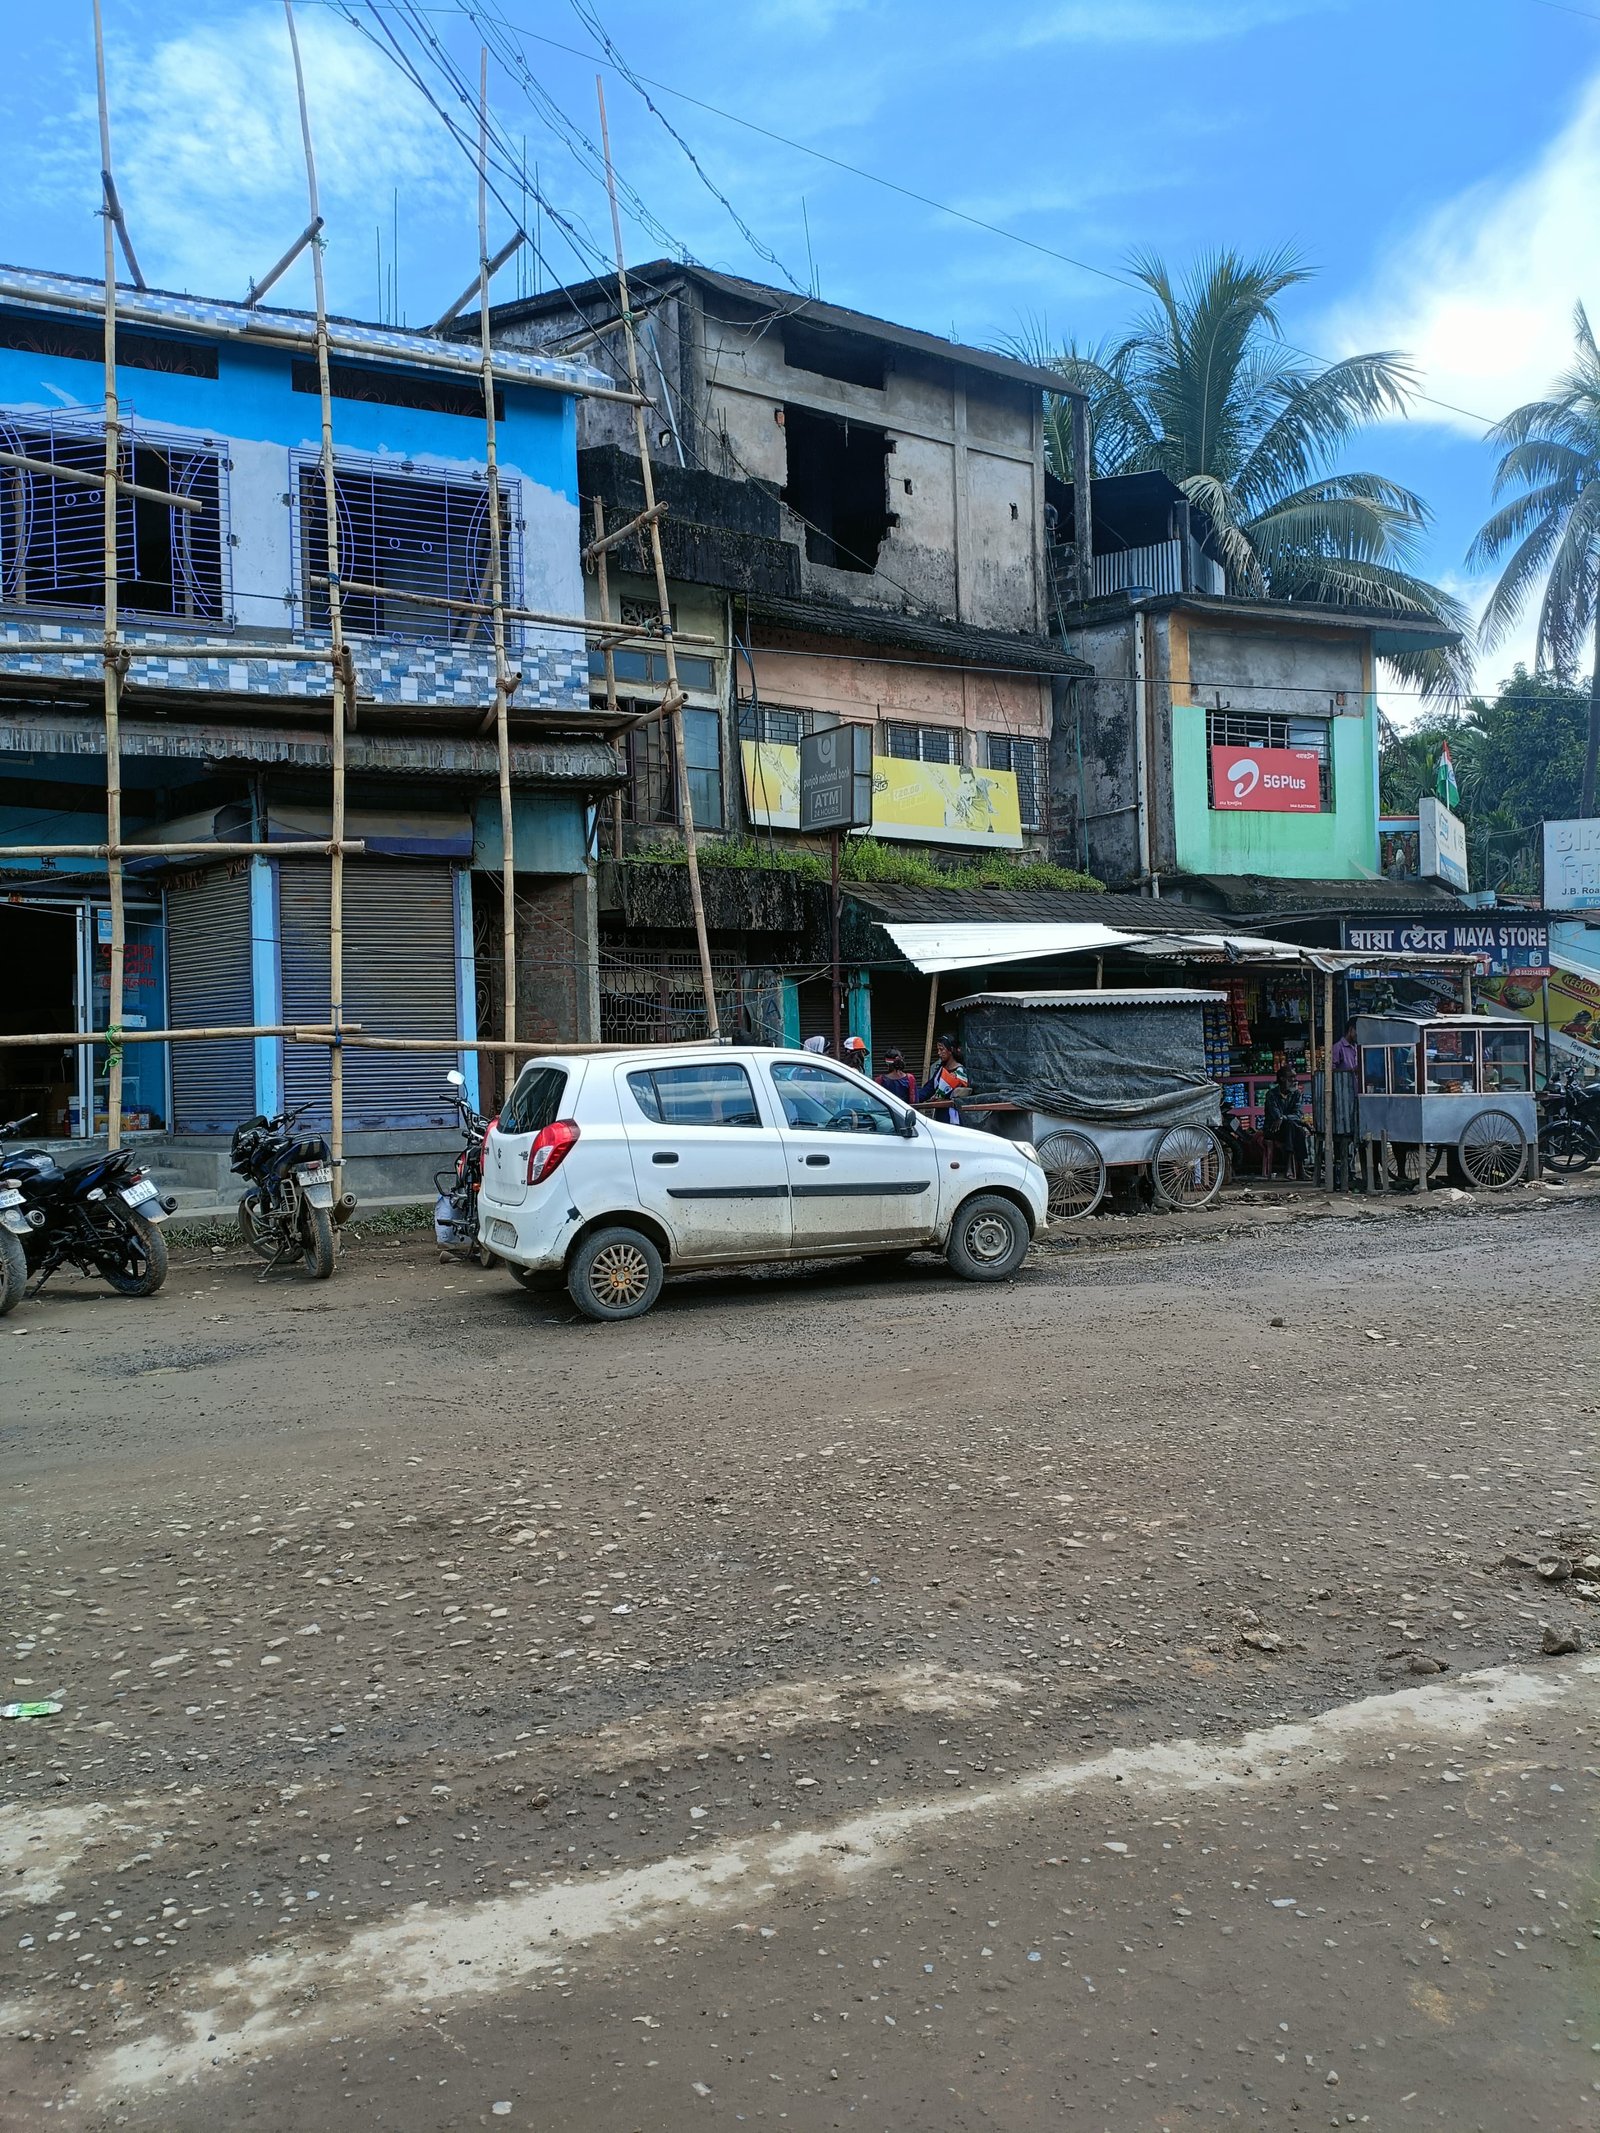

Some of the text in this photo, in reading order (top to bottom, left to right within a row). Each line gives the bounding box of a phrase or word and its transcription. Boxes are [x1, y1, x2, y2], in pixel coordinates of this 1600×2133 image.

[1281, 775, 1306, 789] Plus
[814, 790, 839, 809] ATM
[814, 805, 839, 818] 24 HOURS
[1561, 887, 1579, 896] J.B.
[1349, 929, 1395, 951] মায়া
[1453, 927, 1548, 947] MAYA STORE
[1563, 975, 1598, 995] KEEKOO
